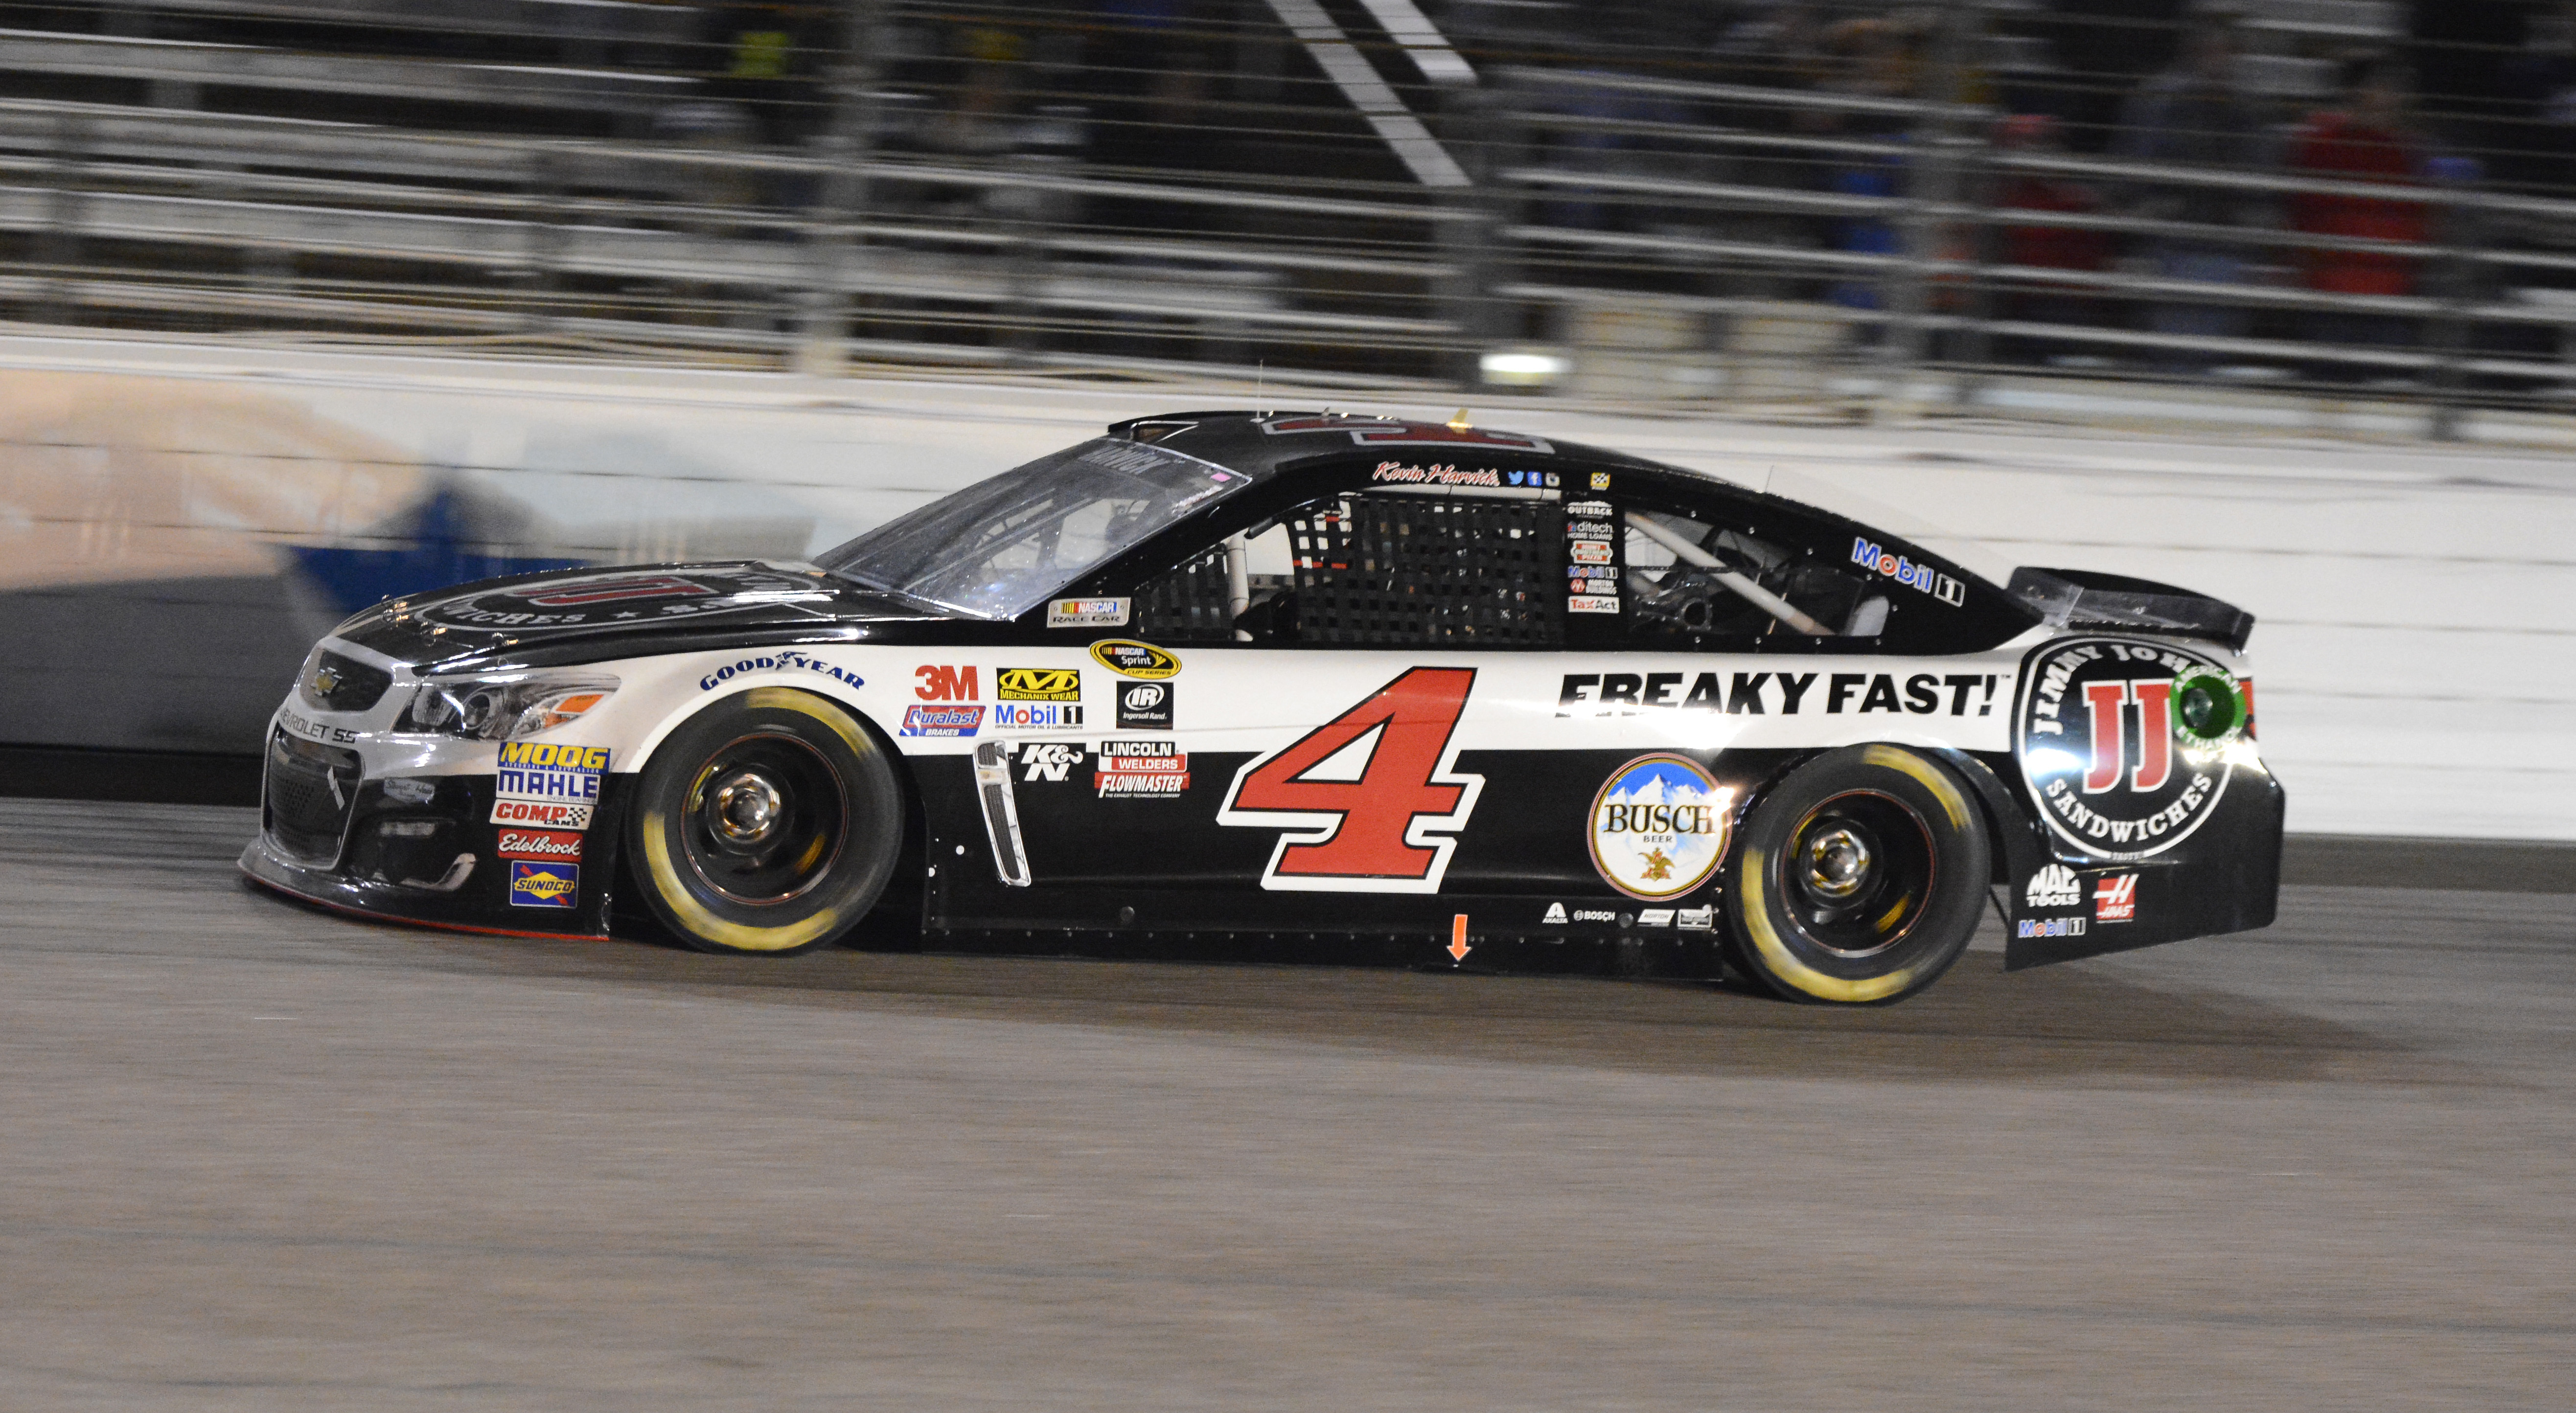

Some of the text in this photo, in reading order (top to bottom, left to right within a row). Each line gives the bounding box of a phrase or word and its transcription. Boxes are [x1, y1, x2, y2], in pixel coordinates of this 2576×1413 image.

[1373, 461, 1500, 486] Kevin Harvick
[1567, 506, 1613, 516] OUTBACK
[1577, 521, 1613, 533] ditech
[1568, 565, 1605, 578] Mobil
[1851, 537, 1934, 593] Mobil
[1078, 602, 1114, 613] NASCAR
[1571, 598, 1616, 609] TaxAct
[1115, 647, 1145, 656] NASCAR
[1121, 655, 1151, 666] Sprint
[700, 657, 865, 690] GOODYEAR
[915, 665, 979, 701] 3M
[2034, 645, 2103, 735] JIMMY
[1000, 689, 1079, 701] MECHANIX WEAR
[1555, 672, 1997, 717] FREAKY FAST!
[908, 708, 980, 726] Duralast
[995, 705, 1057, 724] Mobil
[1123, 711, 1149, 720] Ingersoll
[332, 727, 361, 744] SS
[925, 728, 960, 736] BRAKES
[2082, 679, 2175, 795] JJ
[500, 742, 609, 769] MOOG
[1104, 742, 1172, 757] LINCOLN
[1118, 759, 1178, 770] WELDERS
[498, 770, 598, 798] MAHLE
[1222, 665, 1482, 887] 4
[1098, 775, 1184, 798] FLOWMASTER
[496, 803, 568, 821] COMP
[2046, 773, 2211, 843] SANDWICHES
[1603, 803, 1717, 835] BUSCH
[499, 833, 581, 856] Edelbrock
[516, 880, 573, 891] SUNOCO
[2026, 864, 2081, 895] MAC
[2026, 894, 2081, 907] TOOLS
[1584, 911, 1615, 922] BOSCH
[2018, 918, 2069, 938] Mobil
